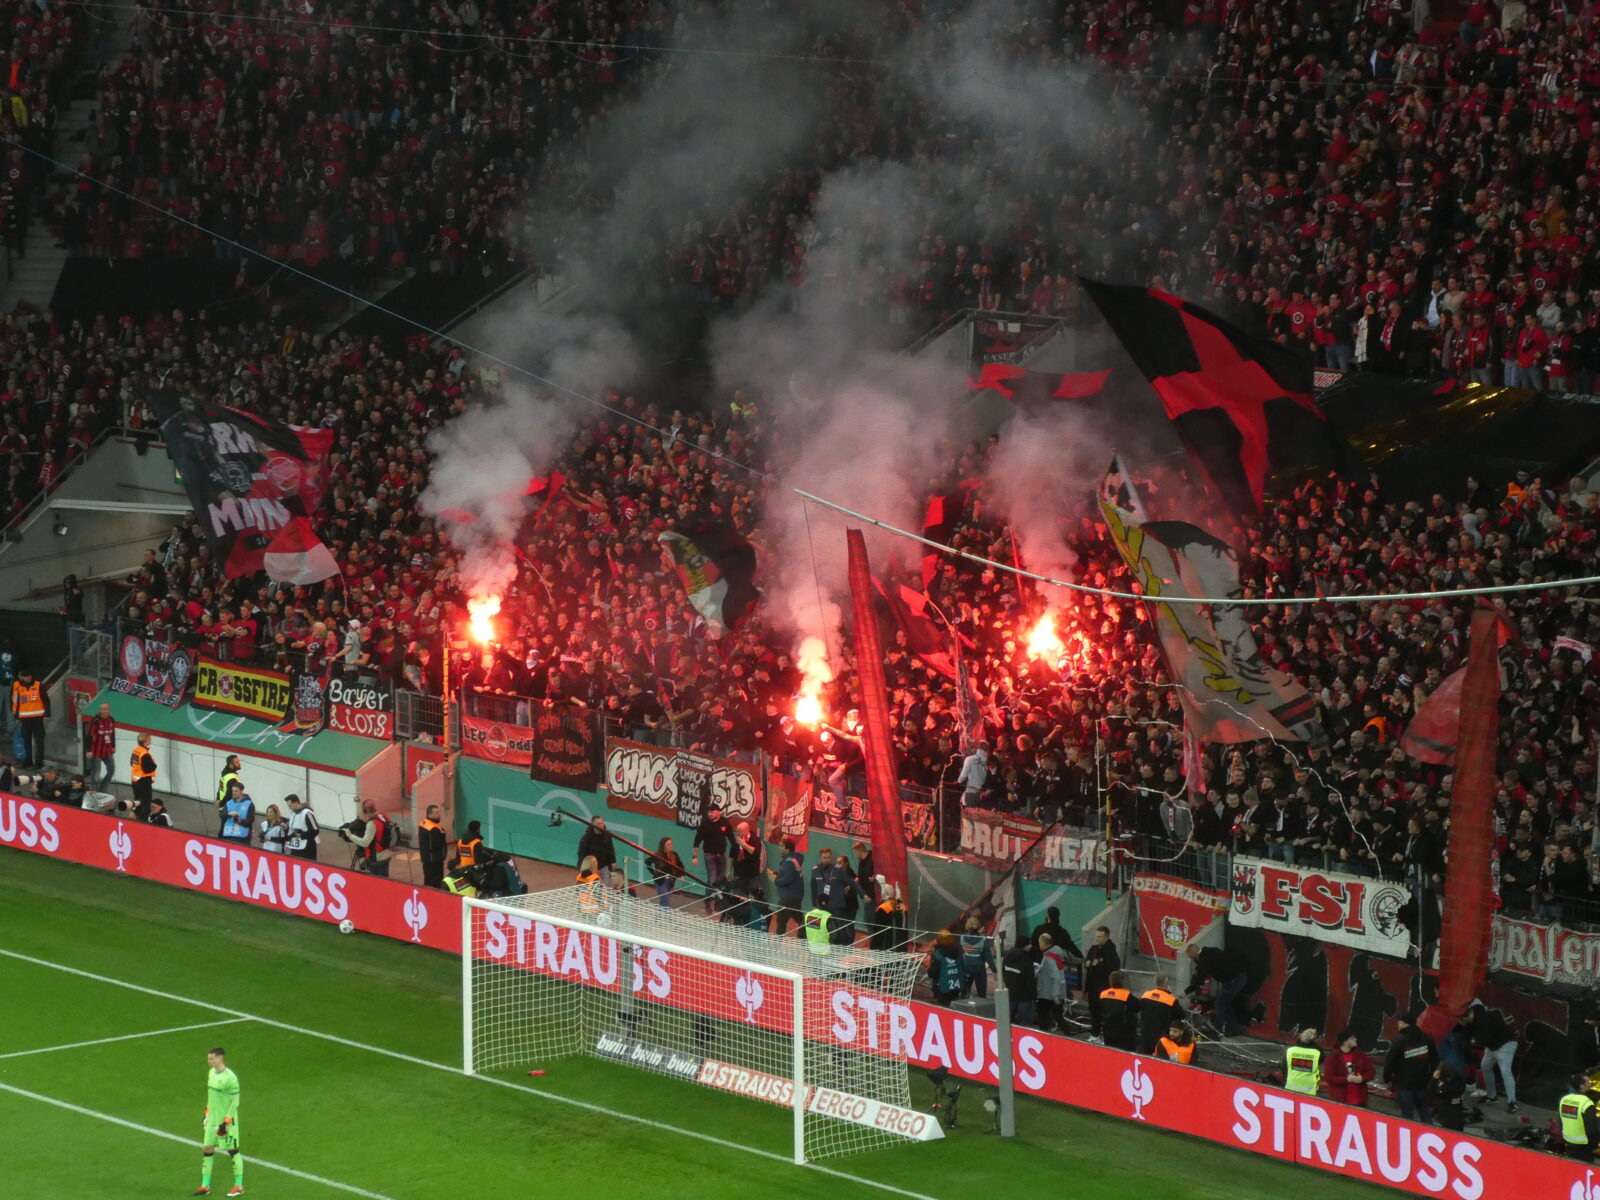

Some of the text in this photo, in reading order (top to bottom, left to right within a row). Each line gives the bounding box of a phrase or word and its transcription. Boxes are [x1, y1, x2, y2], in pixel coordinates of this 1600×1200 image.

[329, 679, 389, 711] Bayer
[184, 839, 349, 920] STRAUSS
[1260, 866, 1366, 934] FSI
[667, 1054, 699, 1077] bwin
[716, 1066, 794, 1104] STRAUSS
[815, 1089, 927, 1137] ERGO ERGO
[1232, 1086, 1484, 1200] STRAUSS
